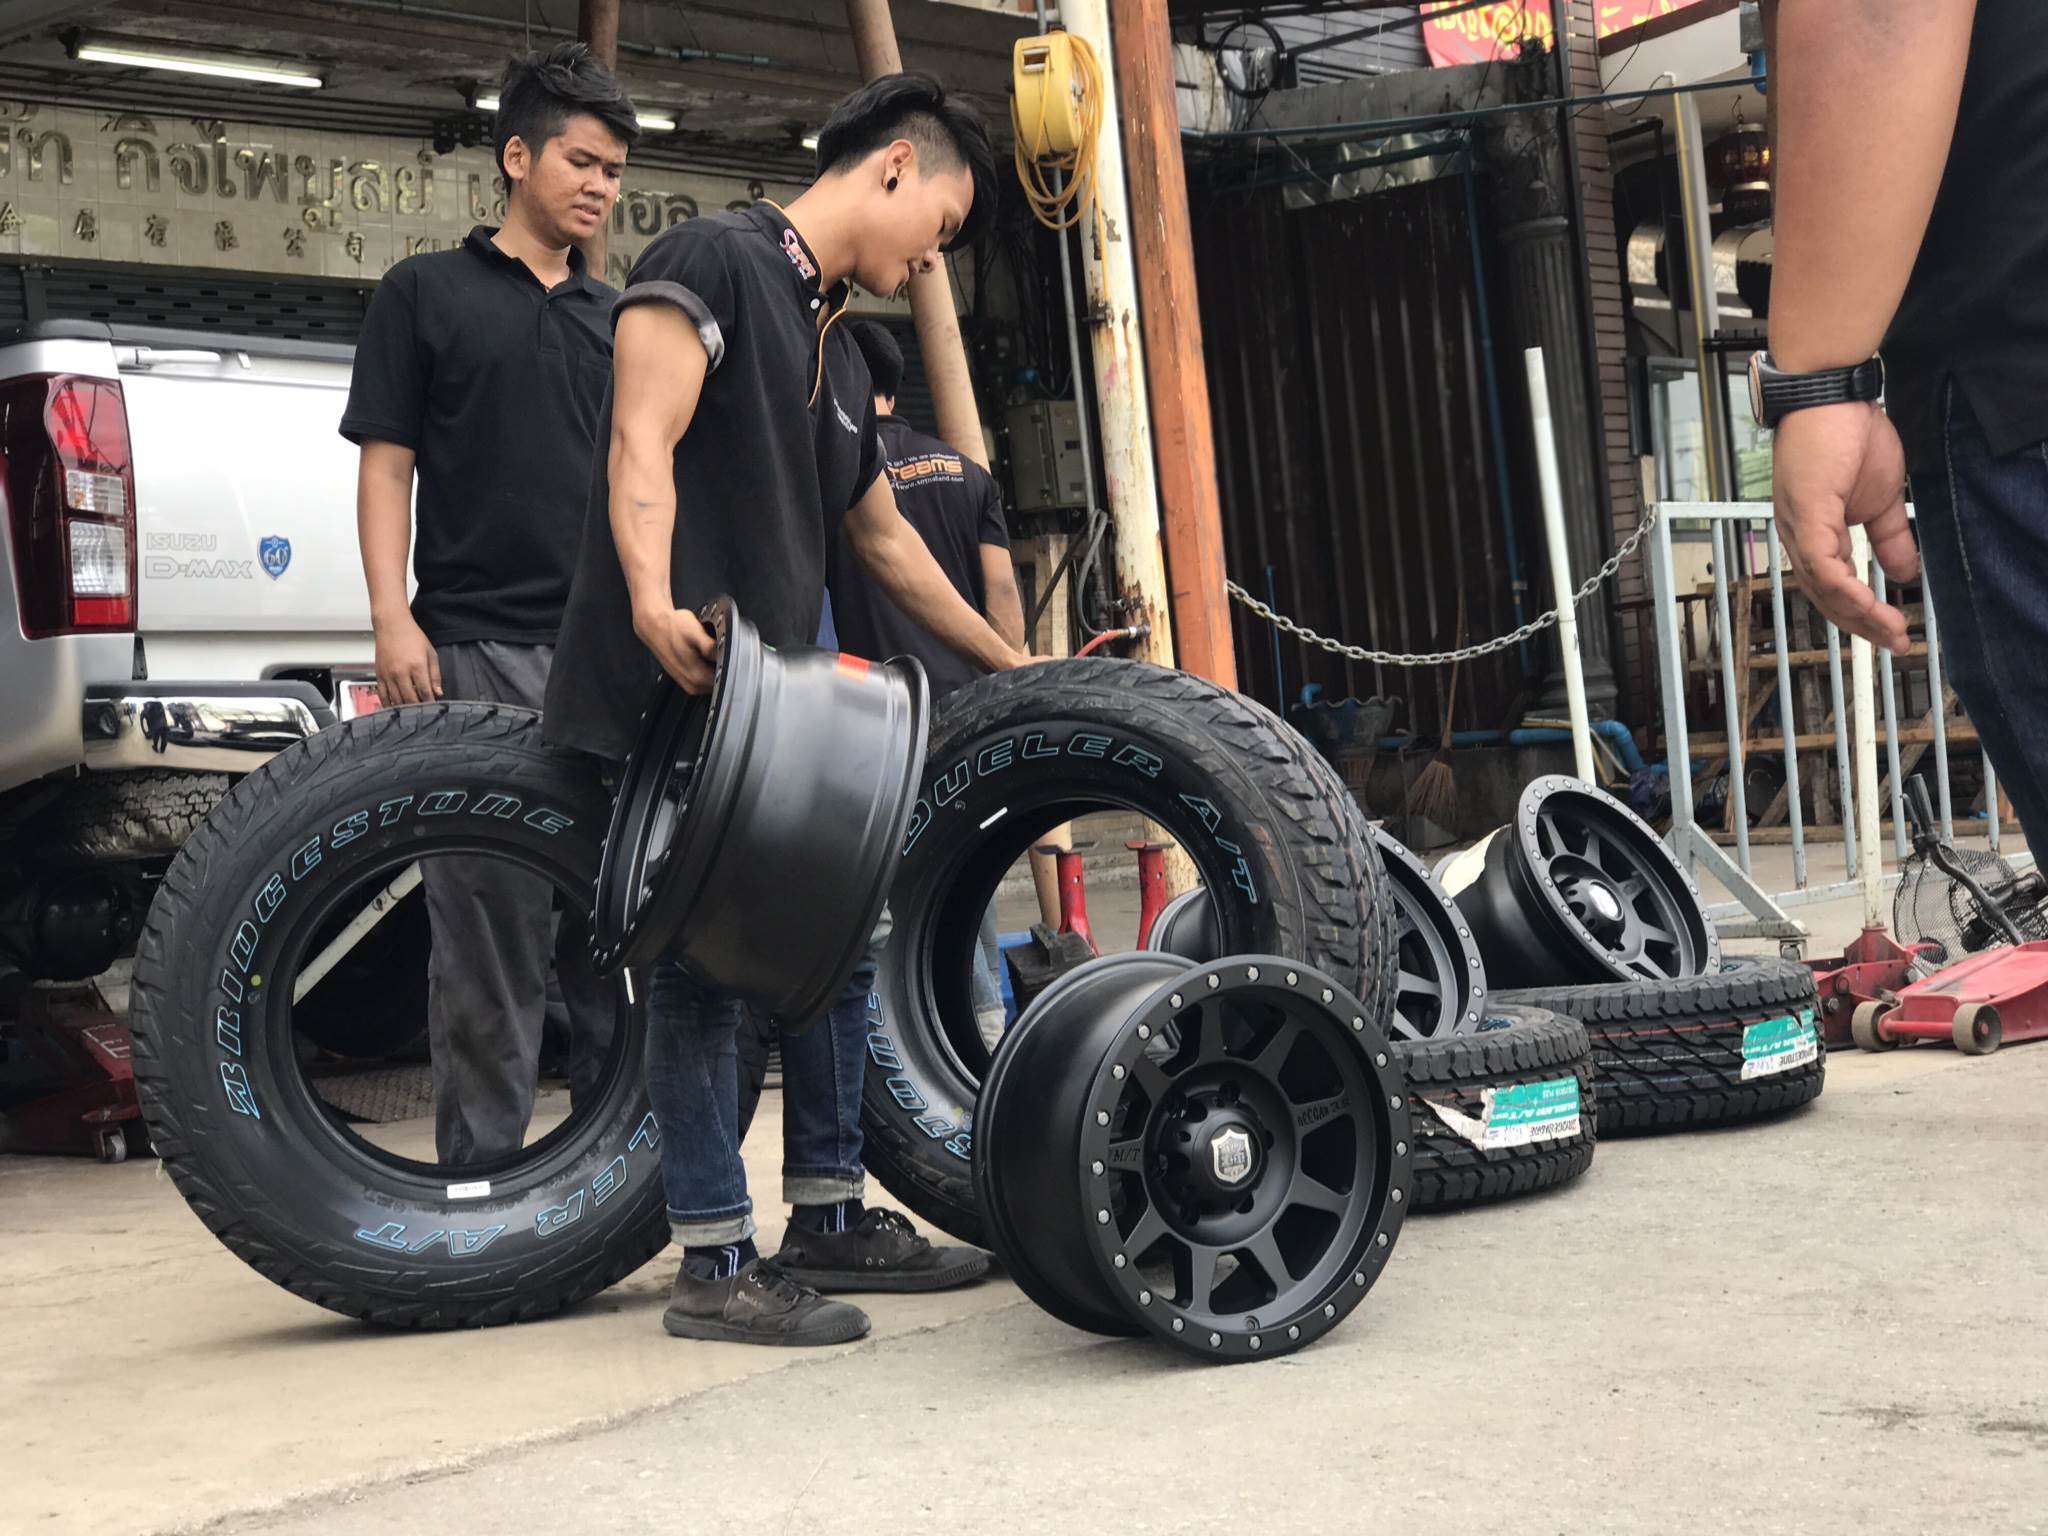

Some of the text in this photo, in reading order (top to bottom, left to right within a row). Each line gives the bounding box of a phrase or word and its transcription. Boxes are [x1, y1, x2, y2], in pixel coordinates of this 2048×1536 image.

[146, 532, 217, 552] ISUZU
[903, 733, 1258, 905] DUELER A/T
[216, 789, 575, 1120] BRIDGESTONE
[355, 1221, 509, 1257] A/T
